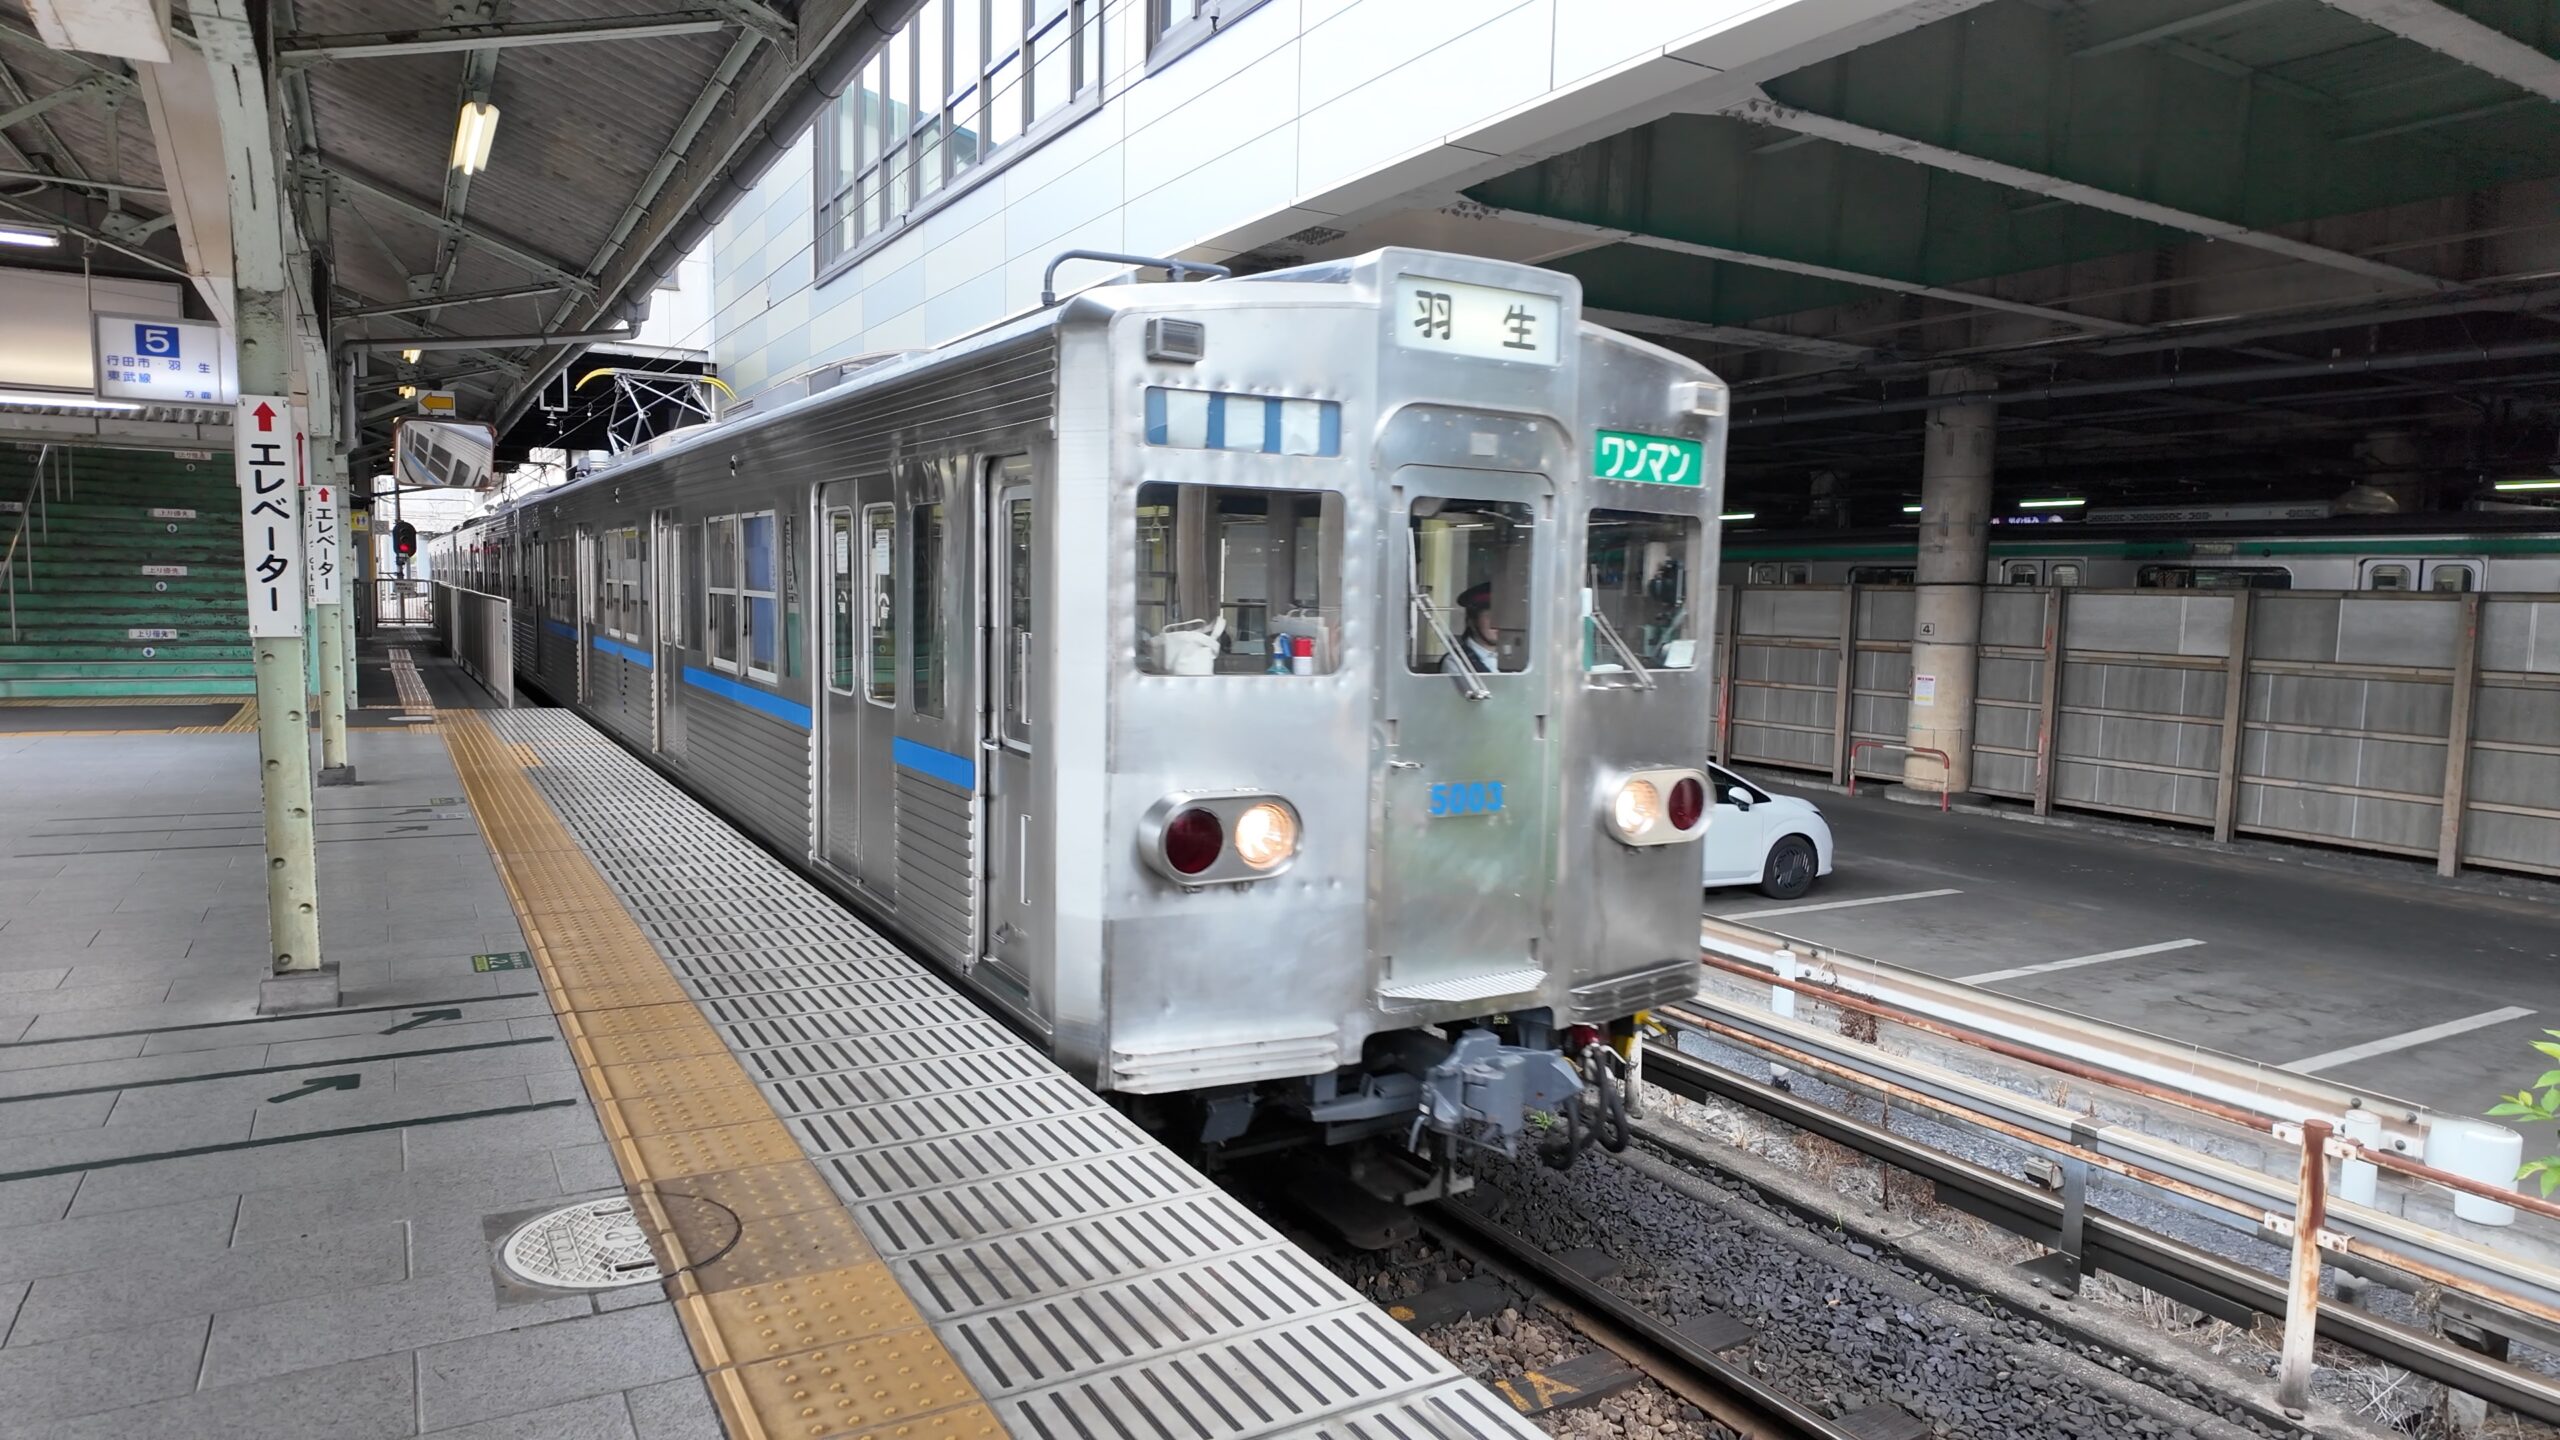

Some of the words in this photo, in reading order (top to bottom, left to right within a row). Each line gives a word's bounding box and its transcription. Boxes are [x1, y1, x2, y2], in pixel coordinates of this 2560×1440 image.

[1414, 290, 1536, 351] 羽生
[145, 329, 170, 353] 5
[107, 370, 151, 383] 東武線
[185, 390, 212, 400] 方面
[1602, 436, 1690, 482] ワンマン
[249, 443, 290, 612] エレベーター
[315, 508, 336, 591] エレベーター
[1922, 624, 1932, 634] 4
[1431, 781, 1504, 816] 5003
